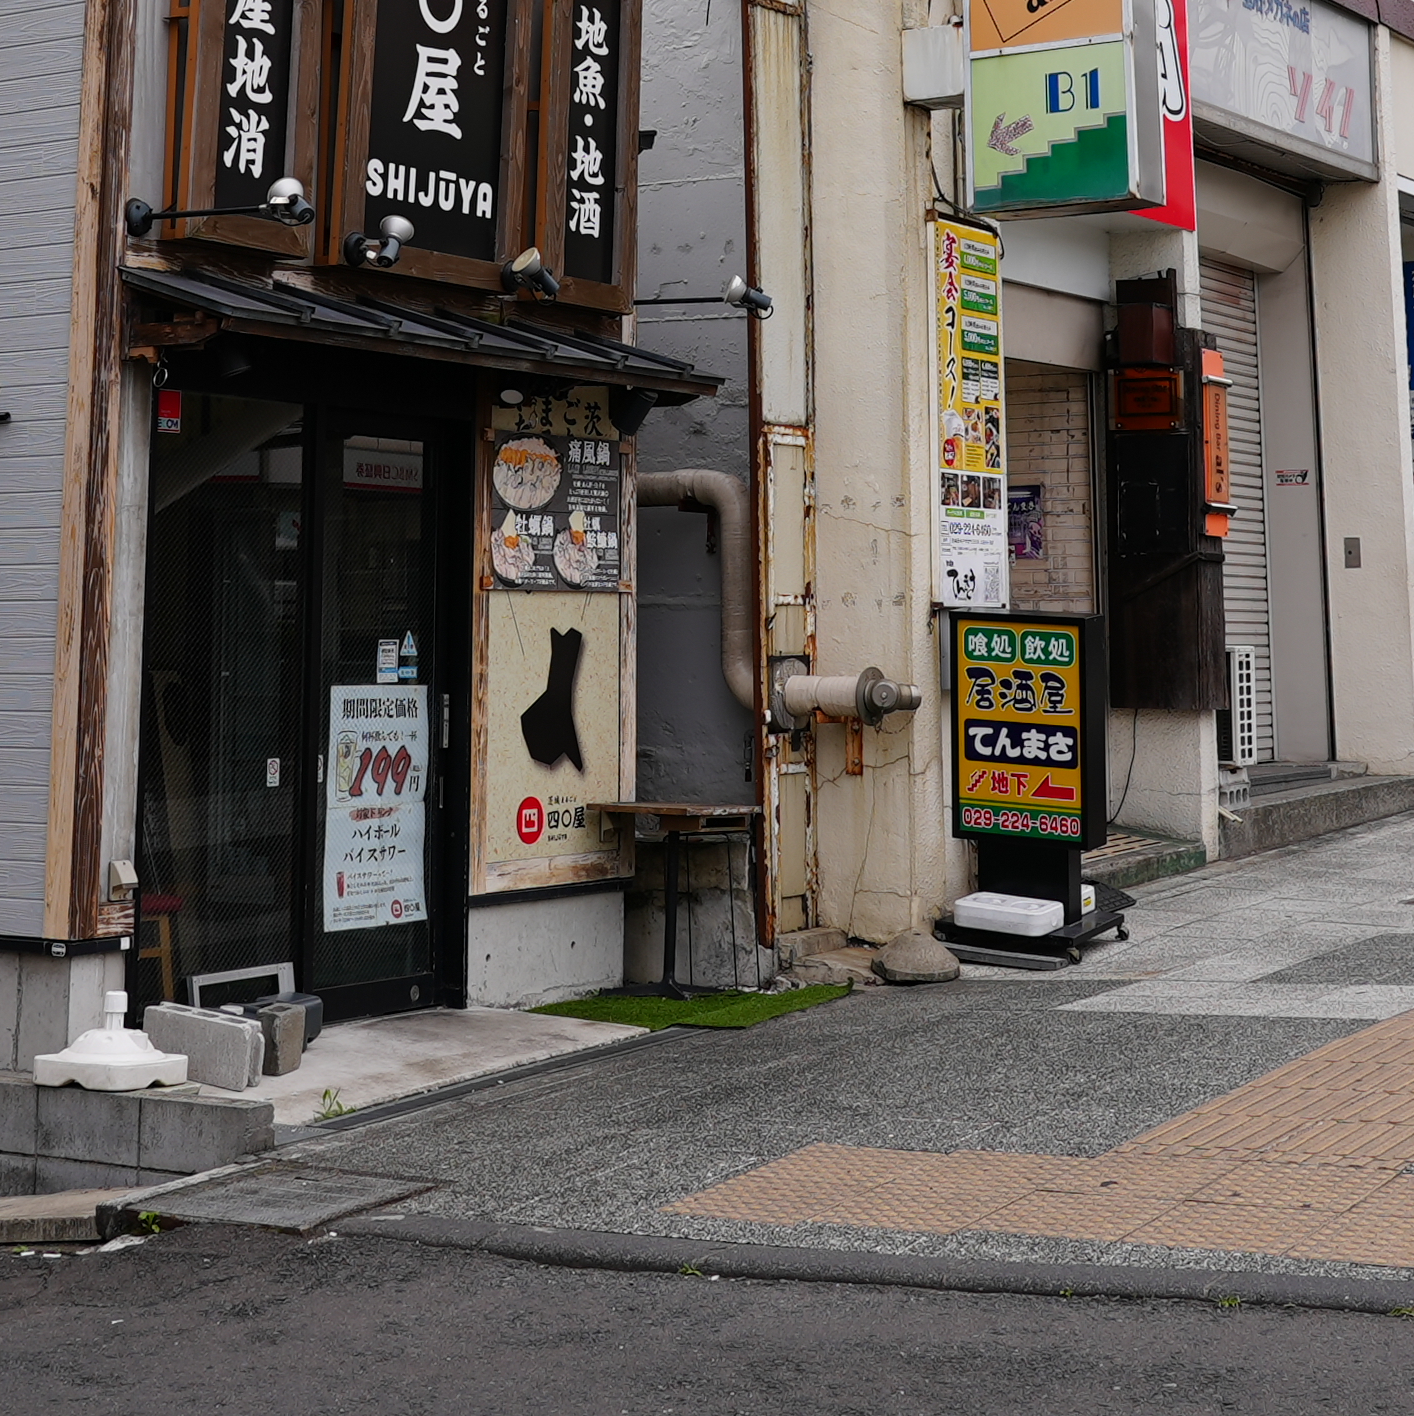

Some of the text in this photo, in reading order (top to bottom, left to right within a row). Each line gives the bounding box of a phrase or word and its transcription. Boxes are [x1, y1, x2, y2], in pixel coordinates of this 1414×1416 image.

[1045, 67, 1100, 115] B1
[569, 4, 610, 239] 地魚・地酒
[967, 632, 1070, 662] 喰処 飲処
[966, 666, 1075, 715] 居酒屋
[342, 698, 418, 720] 期間限定価格
[968, 726, 1074, 762] てんまさ
[349, 745, 419, 796] 199 円
[991, 770, 1029, 796] 地下
[352, 824, 401, 840] ハイボール
[962, 808, 1081, 837] 029-224-6460
[343, 847, 406, 863] バイスサワー
